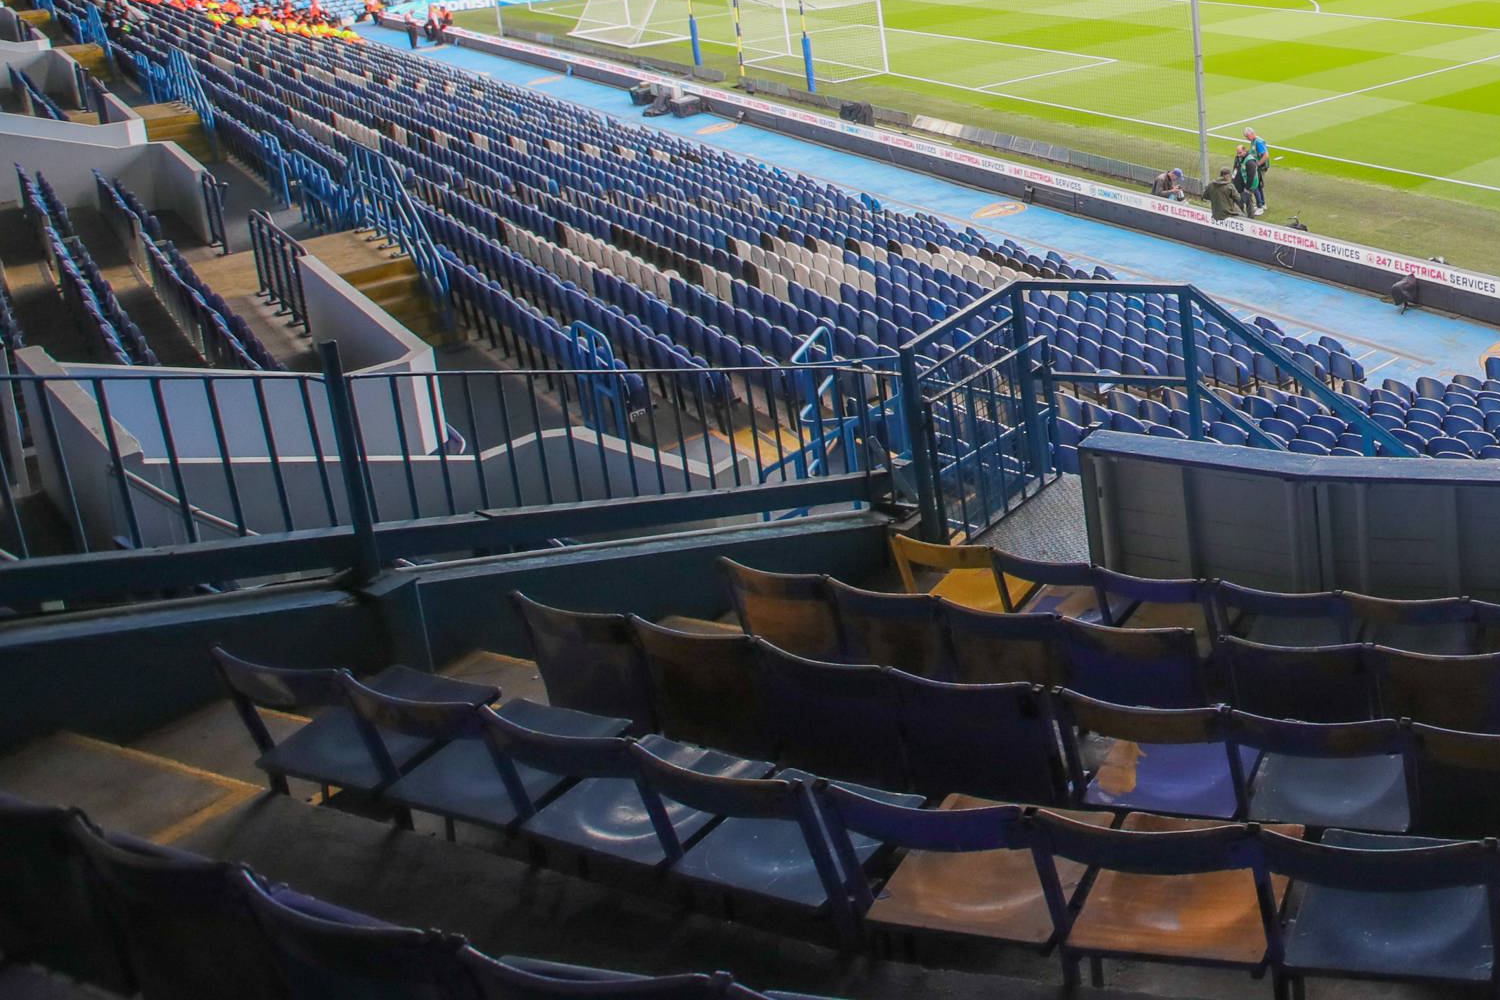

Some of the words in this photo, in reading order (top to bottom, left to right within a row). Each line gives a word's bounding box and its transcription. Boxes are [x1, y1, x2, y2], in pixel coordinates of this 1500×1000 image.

[1024, 168, 1054, 185] ELECTRICAL
[1055, 178, 1081, 191] SERVICES
[1170, 205, 1210, 224] ELECTRICAL
[1258, 226, 1272, 238] 247
[1273, 230, 1319, 251] ELECTRICAL
[1321, 242, 1360, 260] SERVICES
[1376, 255, 1392, 268] 247
[1394, 259, 1448, 282] ELECTRICAL
[1449, 273, 1496, 294] SERVICES
